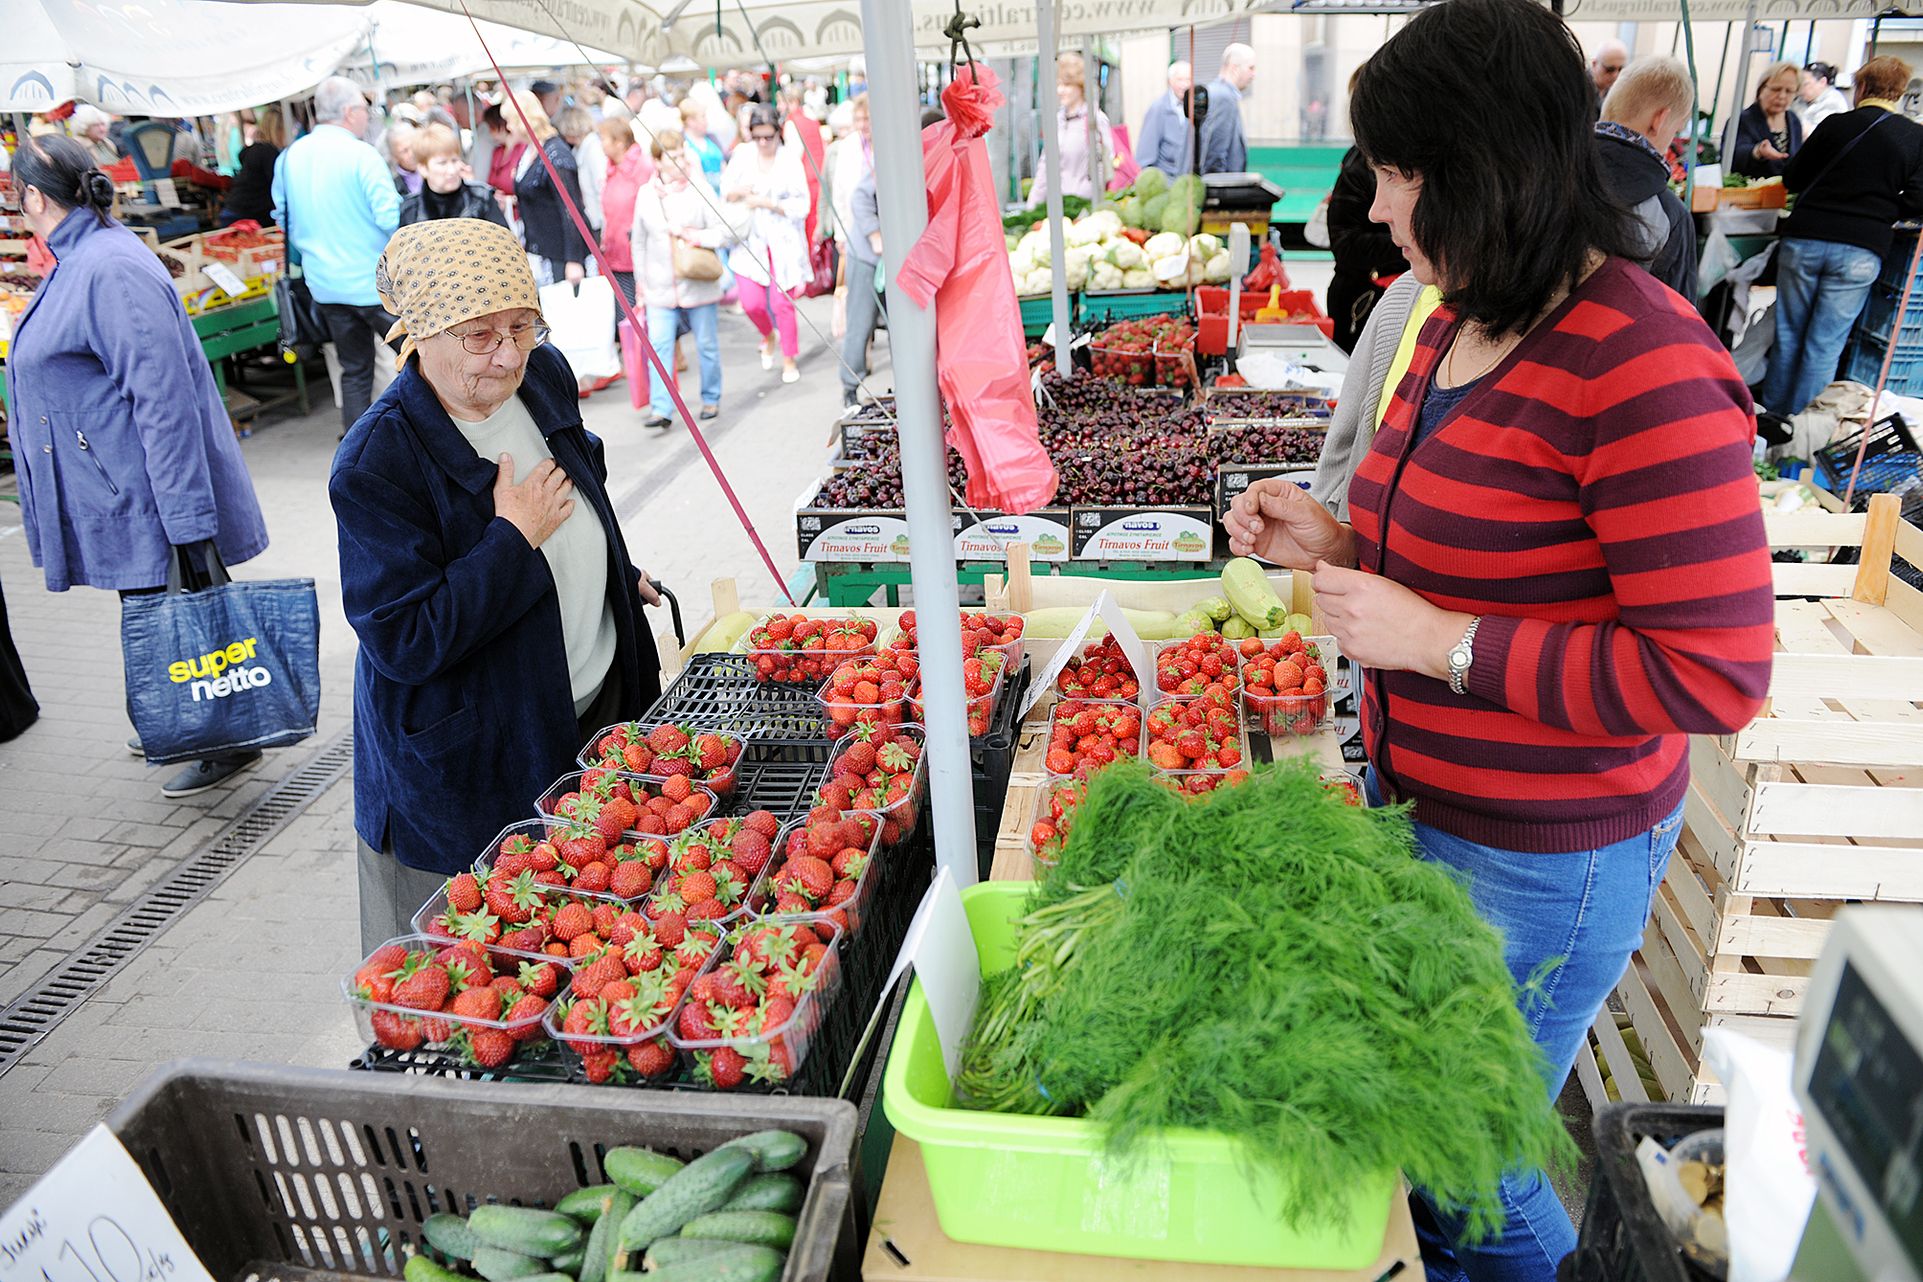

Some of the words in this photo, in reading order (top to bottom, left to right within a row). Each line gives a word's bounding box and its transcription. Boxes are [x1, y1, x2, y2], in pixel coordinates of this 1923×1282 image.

[820, 541, 861, 553] Tirnavos
[864, 542, 888, 553] Fruit
[960, 540, 1001, 552] Tirnavos
[1099, 538, 1141, 550] Tirnavos
[1144, 538, 1169, 550] Fruit
[168, 637, 257, 683] super
[190, 666, 272, 702] netto
